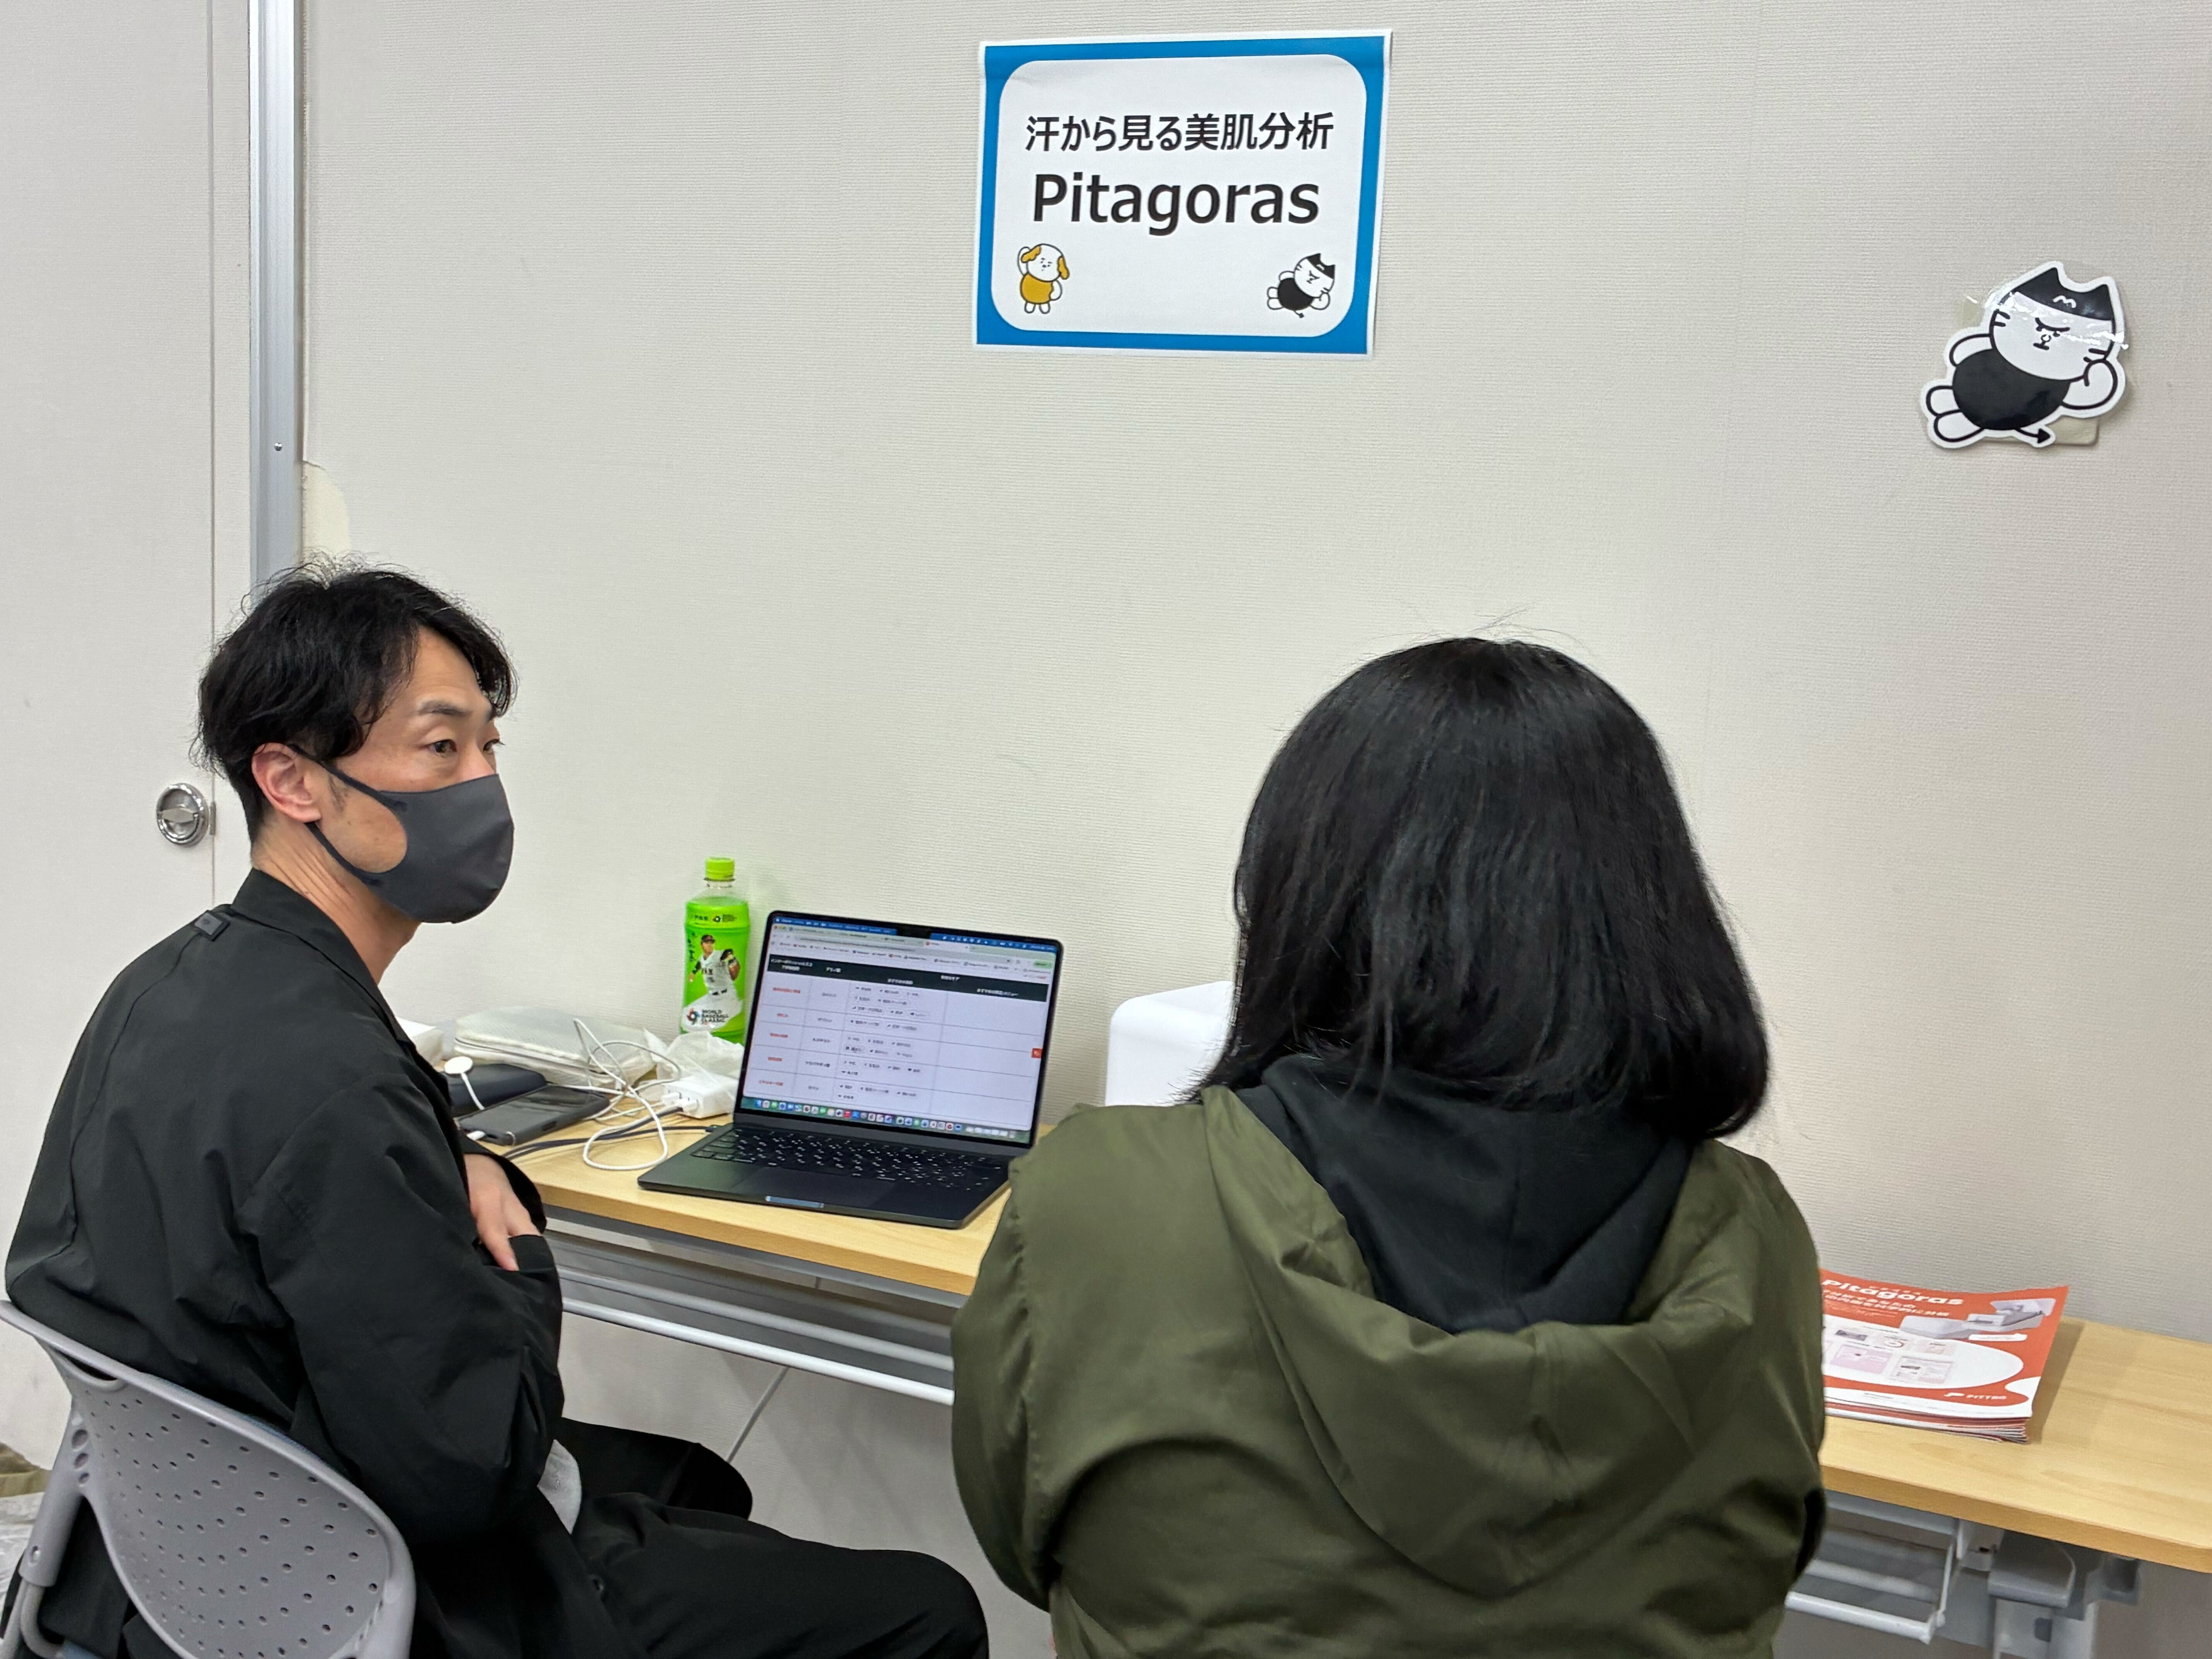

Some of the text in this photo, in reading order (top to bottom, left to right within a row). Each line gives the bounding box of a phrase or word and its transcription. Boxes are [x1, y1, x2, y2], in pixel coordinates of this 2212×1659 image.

[1024, 112, 1334, 152] 汗から見る美肌分析
[1033, 172, 1319, 236] Pitagoras
[1821, 1279, 1964, 1305] Pitagoras
